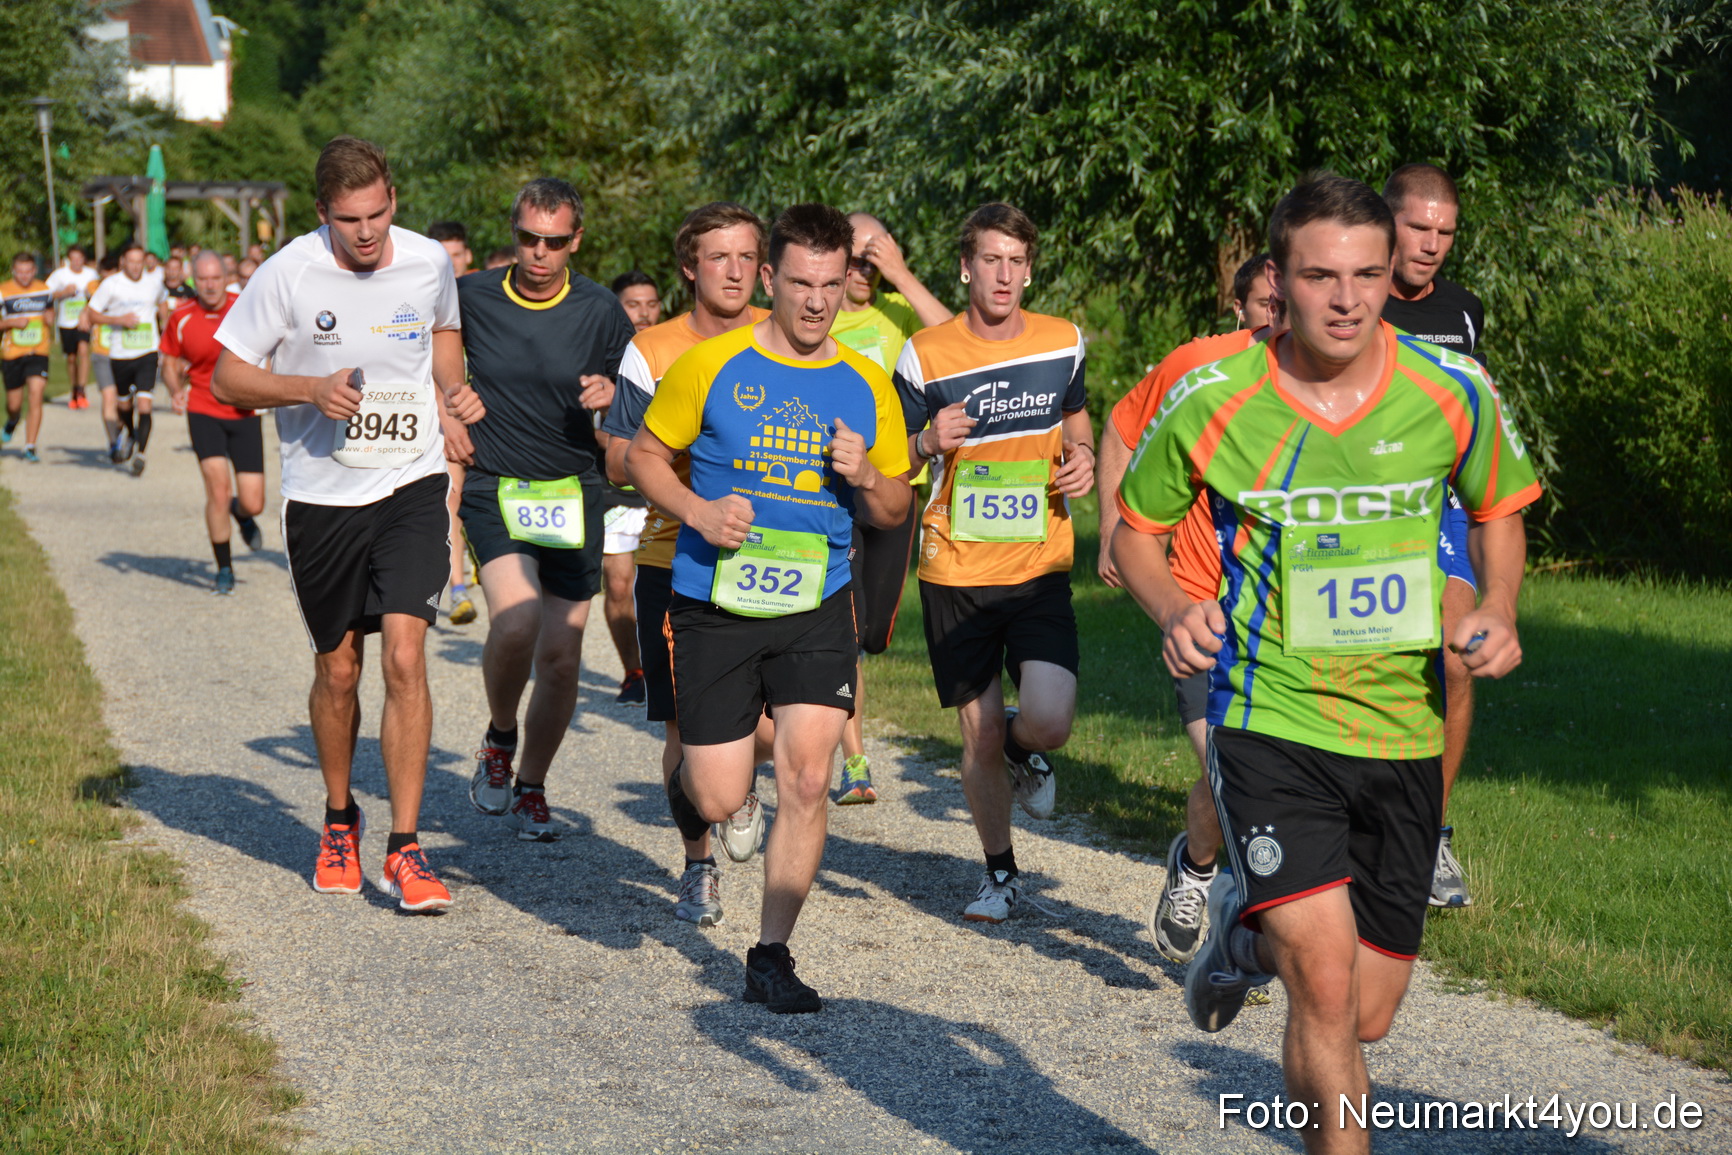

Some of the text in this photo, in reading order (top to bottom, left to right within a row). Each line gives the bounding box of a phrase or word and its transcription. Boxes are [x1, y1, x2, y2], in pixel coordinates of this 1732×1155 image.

[313, 333, 341, 341] PARTL
[739, 393, 759, 401] Jahre
[979, 391, 1057, 417] Fischer
[987, 407, 1051, 424] AUTOMOBILE
[345, 412, 418, 441] 8943
[749, 450, 808, 465] 21.September
[963, 493, 1038, 520] 1539
[1238, 477, 1435, 526] ROCK
[517, 506, 566, 528] 836
[1306, 544, 1361, 559] firmenlauf
[736, 564, 803, 597] 352
[737, 596, 794, 608] Markus Summerer
[1317, 573, 1407, 619] 150
[1333, 625, 1393, 636] Markus Meier
